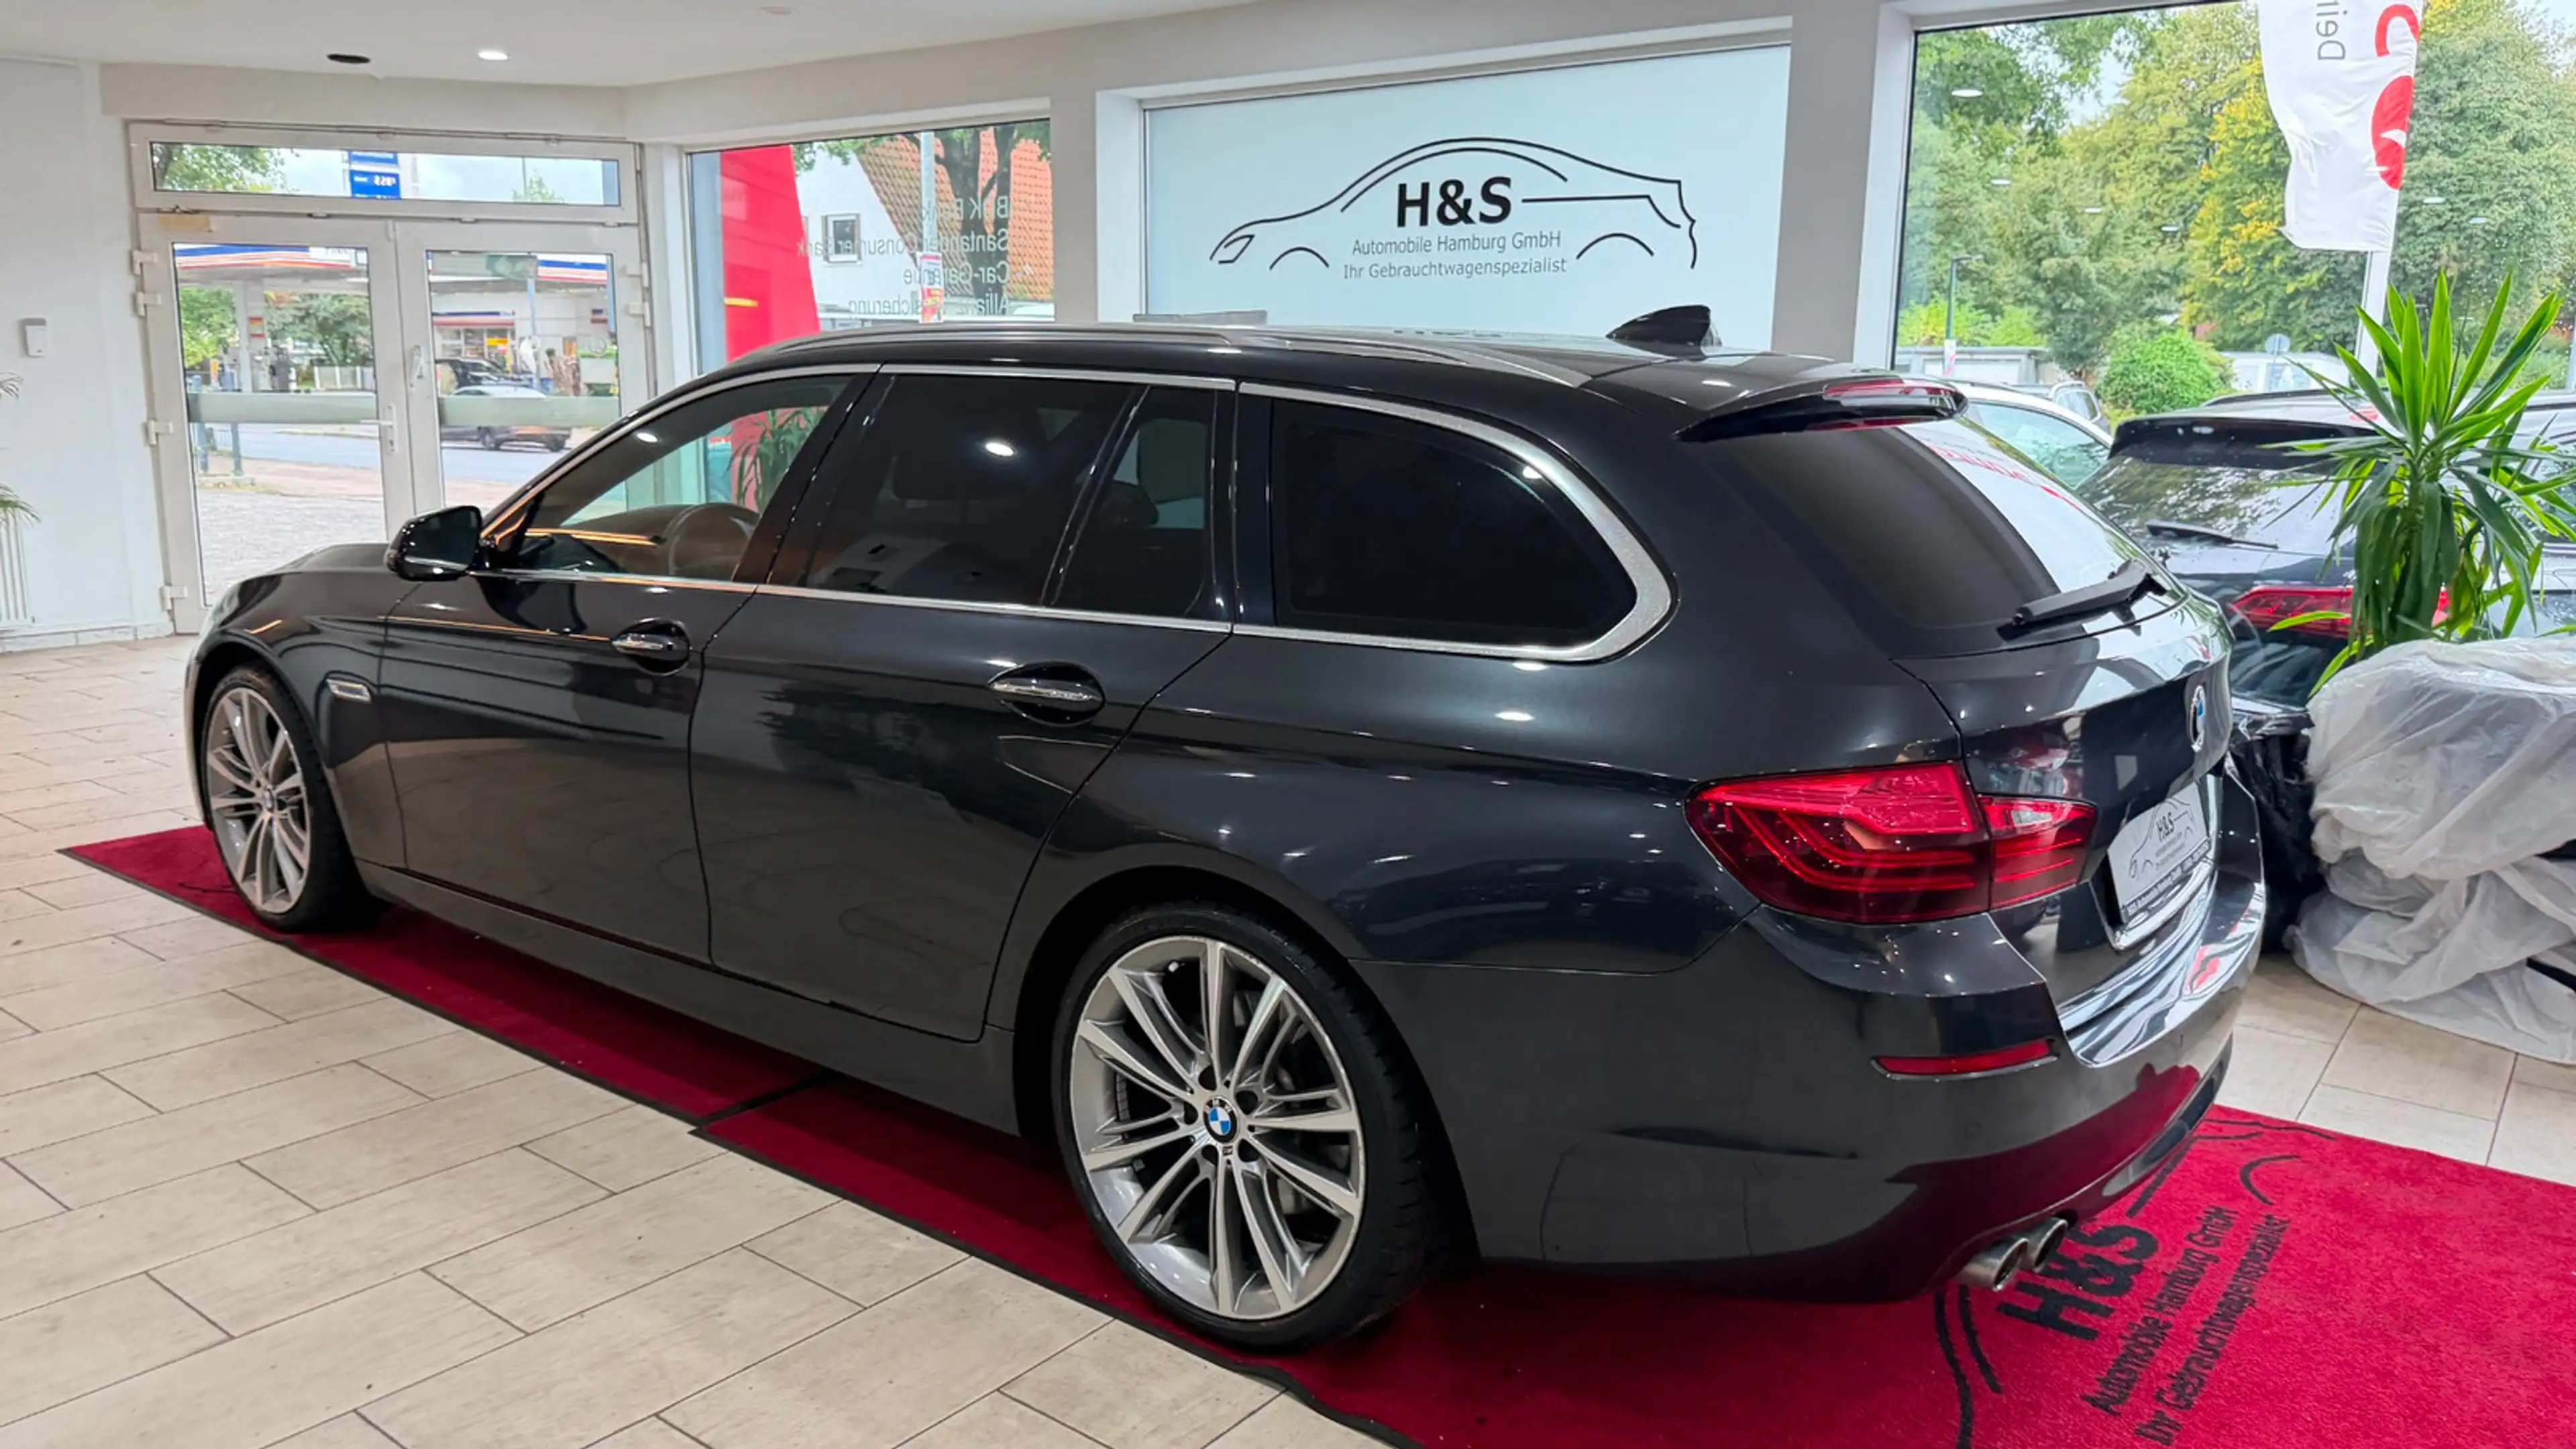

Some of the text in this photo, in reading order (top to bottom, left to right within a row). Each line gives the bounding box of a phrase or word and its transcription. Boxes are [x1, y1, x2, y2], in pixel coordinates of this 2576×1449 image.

[1397, 176, 1511, 227] H&S
[1352, 230, 1562, 256] Automobile Hamburg GmbH
[1344, 258, 1567, 280] Ihr Gebrauchtwagenspezialist
[1996, 1223, 2159, 1341] H&S
[2082, 1204, 2241, 1418] Automobile Hamburg GmbH
